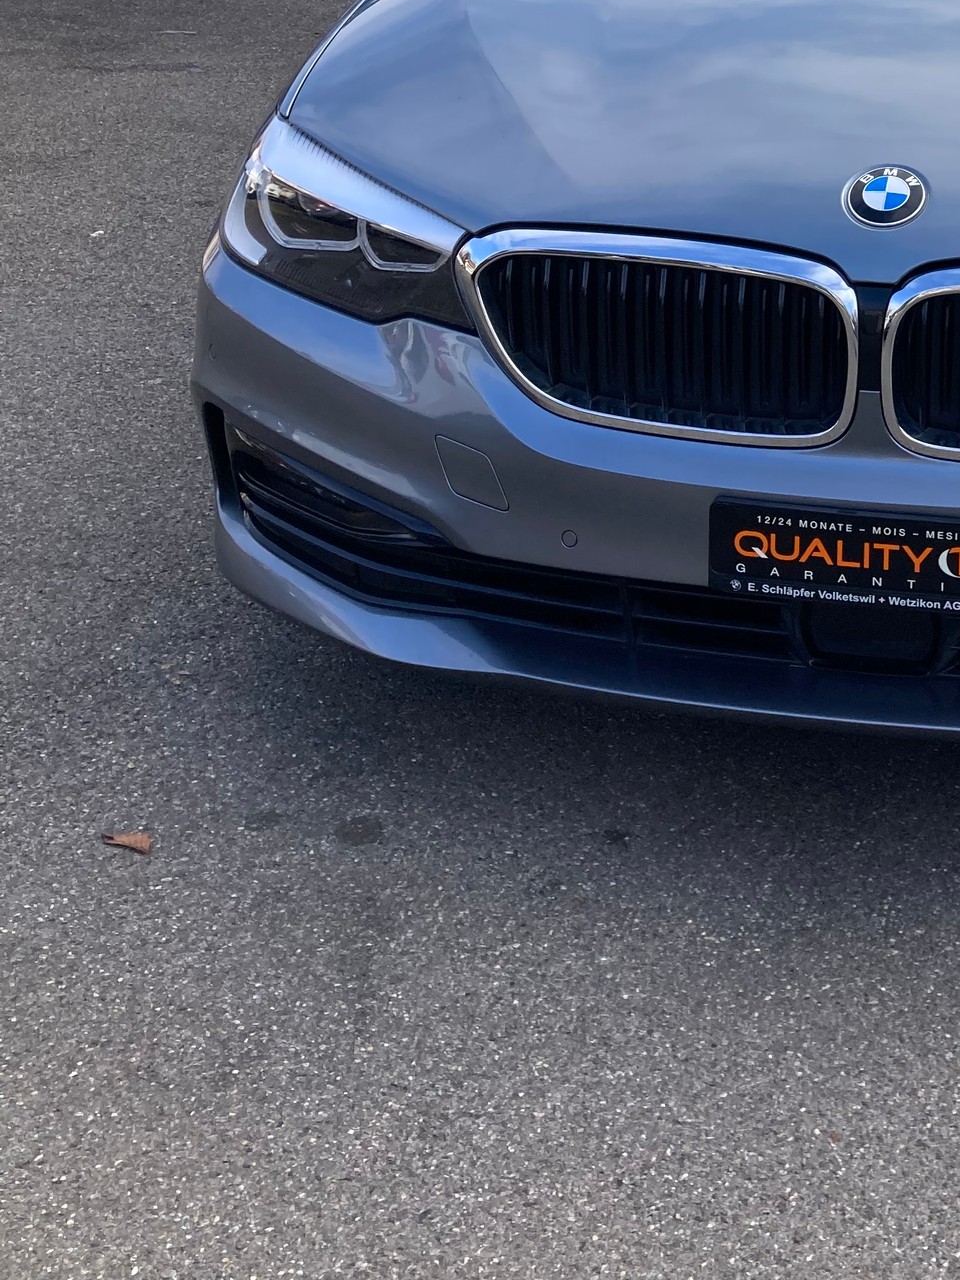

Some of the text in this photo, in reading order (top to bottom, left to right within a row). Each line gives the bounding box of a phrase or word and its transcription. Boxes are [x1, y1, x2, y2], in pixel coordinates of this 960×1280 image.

[859, 168, 920, 187] BMW
[756, 515, 792, 527] 12/24
[799, 520, 853, 533] MONATE
[872, 526, 906, 537] MOIS
[925, 530, 959, 541] MESI
[734, 530, 934, 573] QUALITY
[747, 582, 758, 592] E.
[762, 583, 815, 598] Schläpfer
[818, 589, 875, 604] Volketswil
[889, 596, 941, 609] Wetzikon
